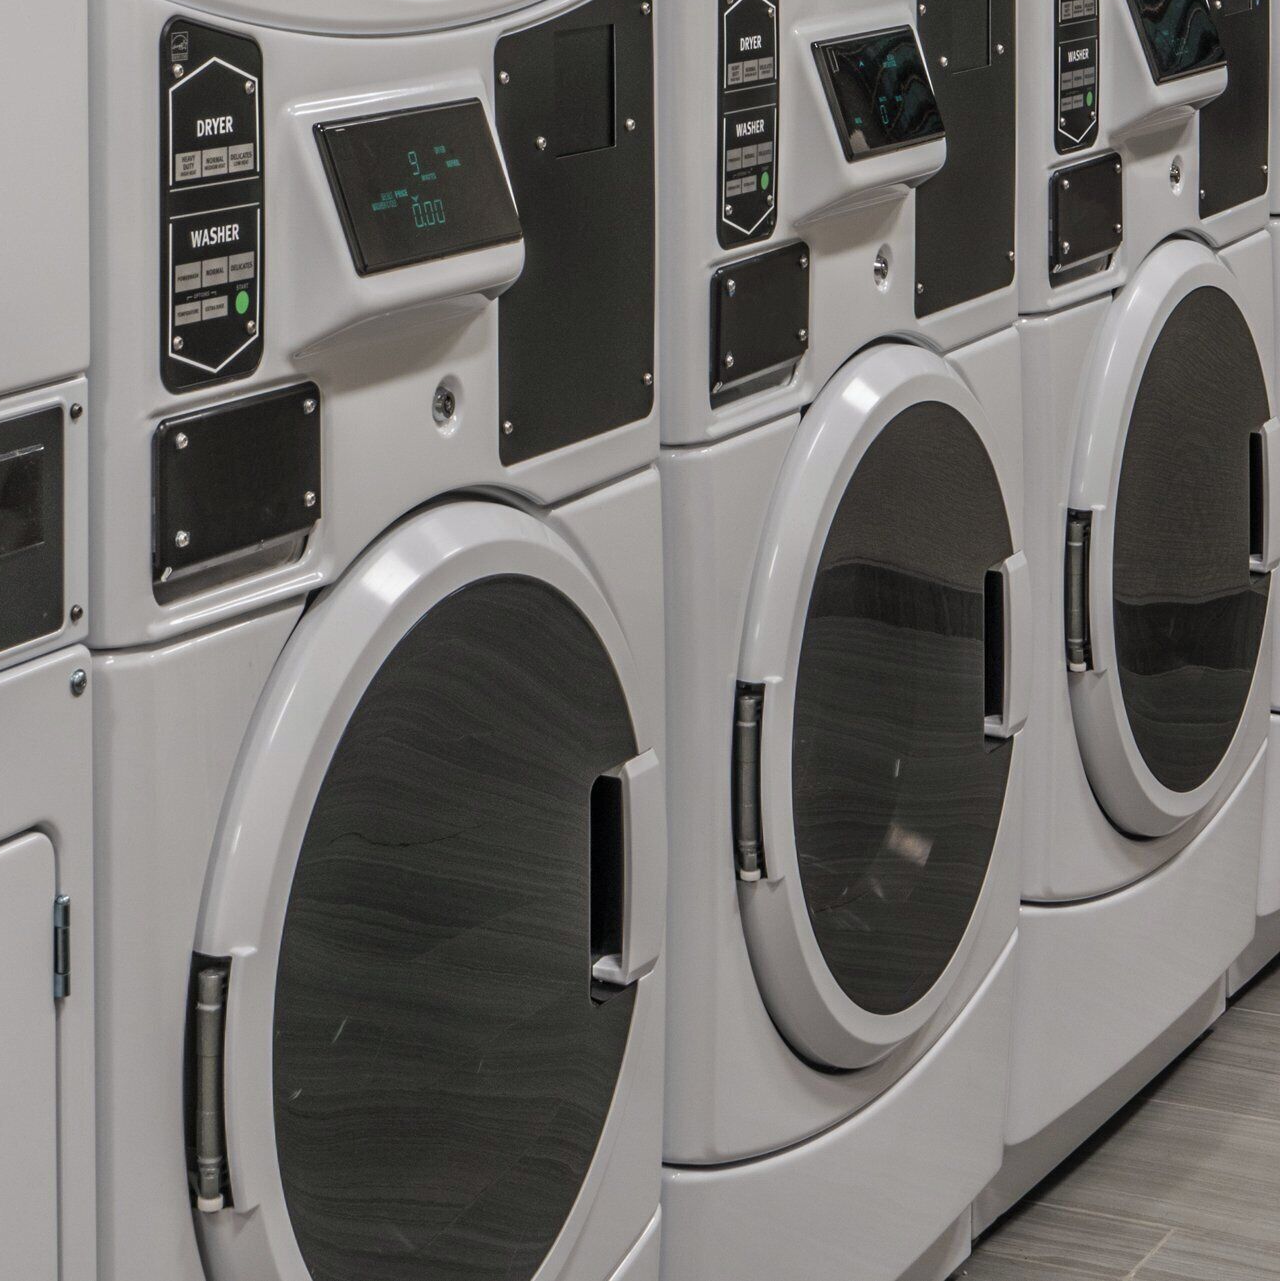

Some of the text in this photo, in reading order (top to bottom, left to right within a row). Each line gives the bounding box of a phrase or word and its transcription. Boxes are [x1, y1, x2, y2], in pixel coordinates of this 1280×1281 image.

[740, 35, 762, 51] DRYER
[1067, 48, 1089, 63] WASHER
[197, 116, 233, 137] DRYER
[736, 119, 765, 137] WASHER
[408, 151, 420, 175] 9
[412, 199, 446, 228] 0.00
[191, 224, 240, 248] WASHER
